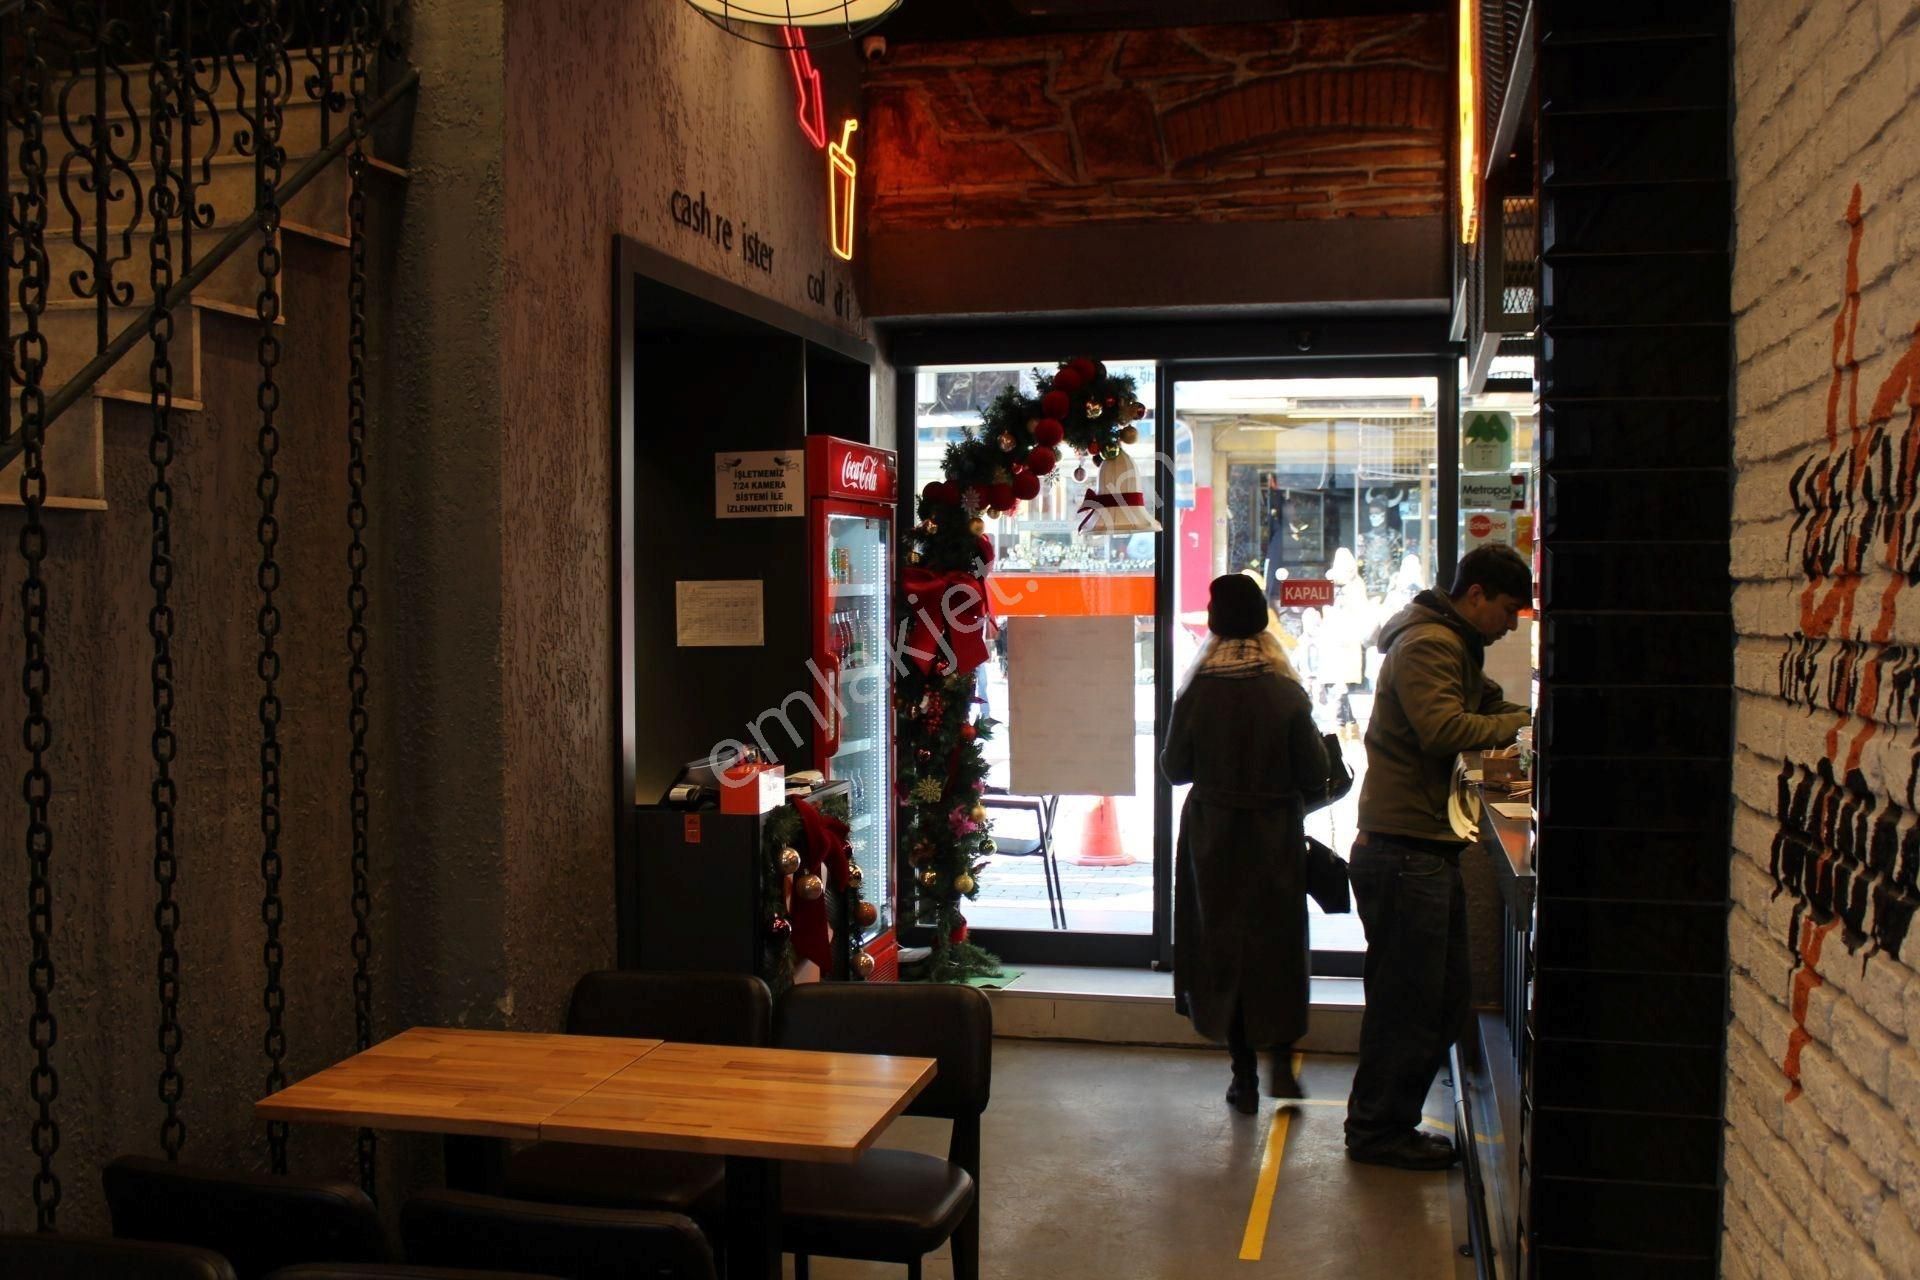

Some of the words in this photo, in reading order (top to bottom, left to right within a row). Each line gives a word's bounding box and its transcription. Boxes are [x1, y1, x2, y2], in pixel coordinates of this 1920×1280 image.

[671, 190, 711, 239] cash
[734, 468, 785, 479] İŞLETMEMİZ
[751, 481, 787, 490] KAMERA
[1463, 485, 1512, 497] Metropol
[735, 492, 768, 502] SİSTEMİ
[770, 492, 784, 501] İLE
[726, 503, 794, 513] İZLENMEKTEDİR
[1284, 588, 1331, 601] KAPALI
